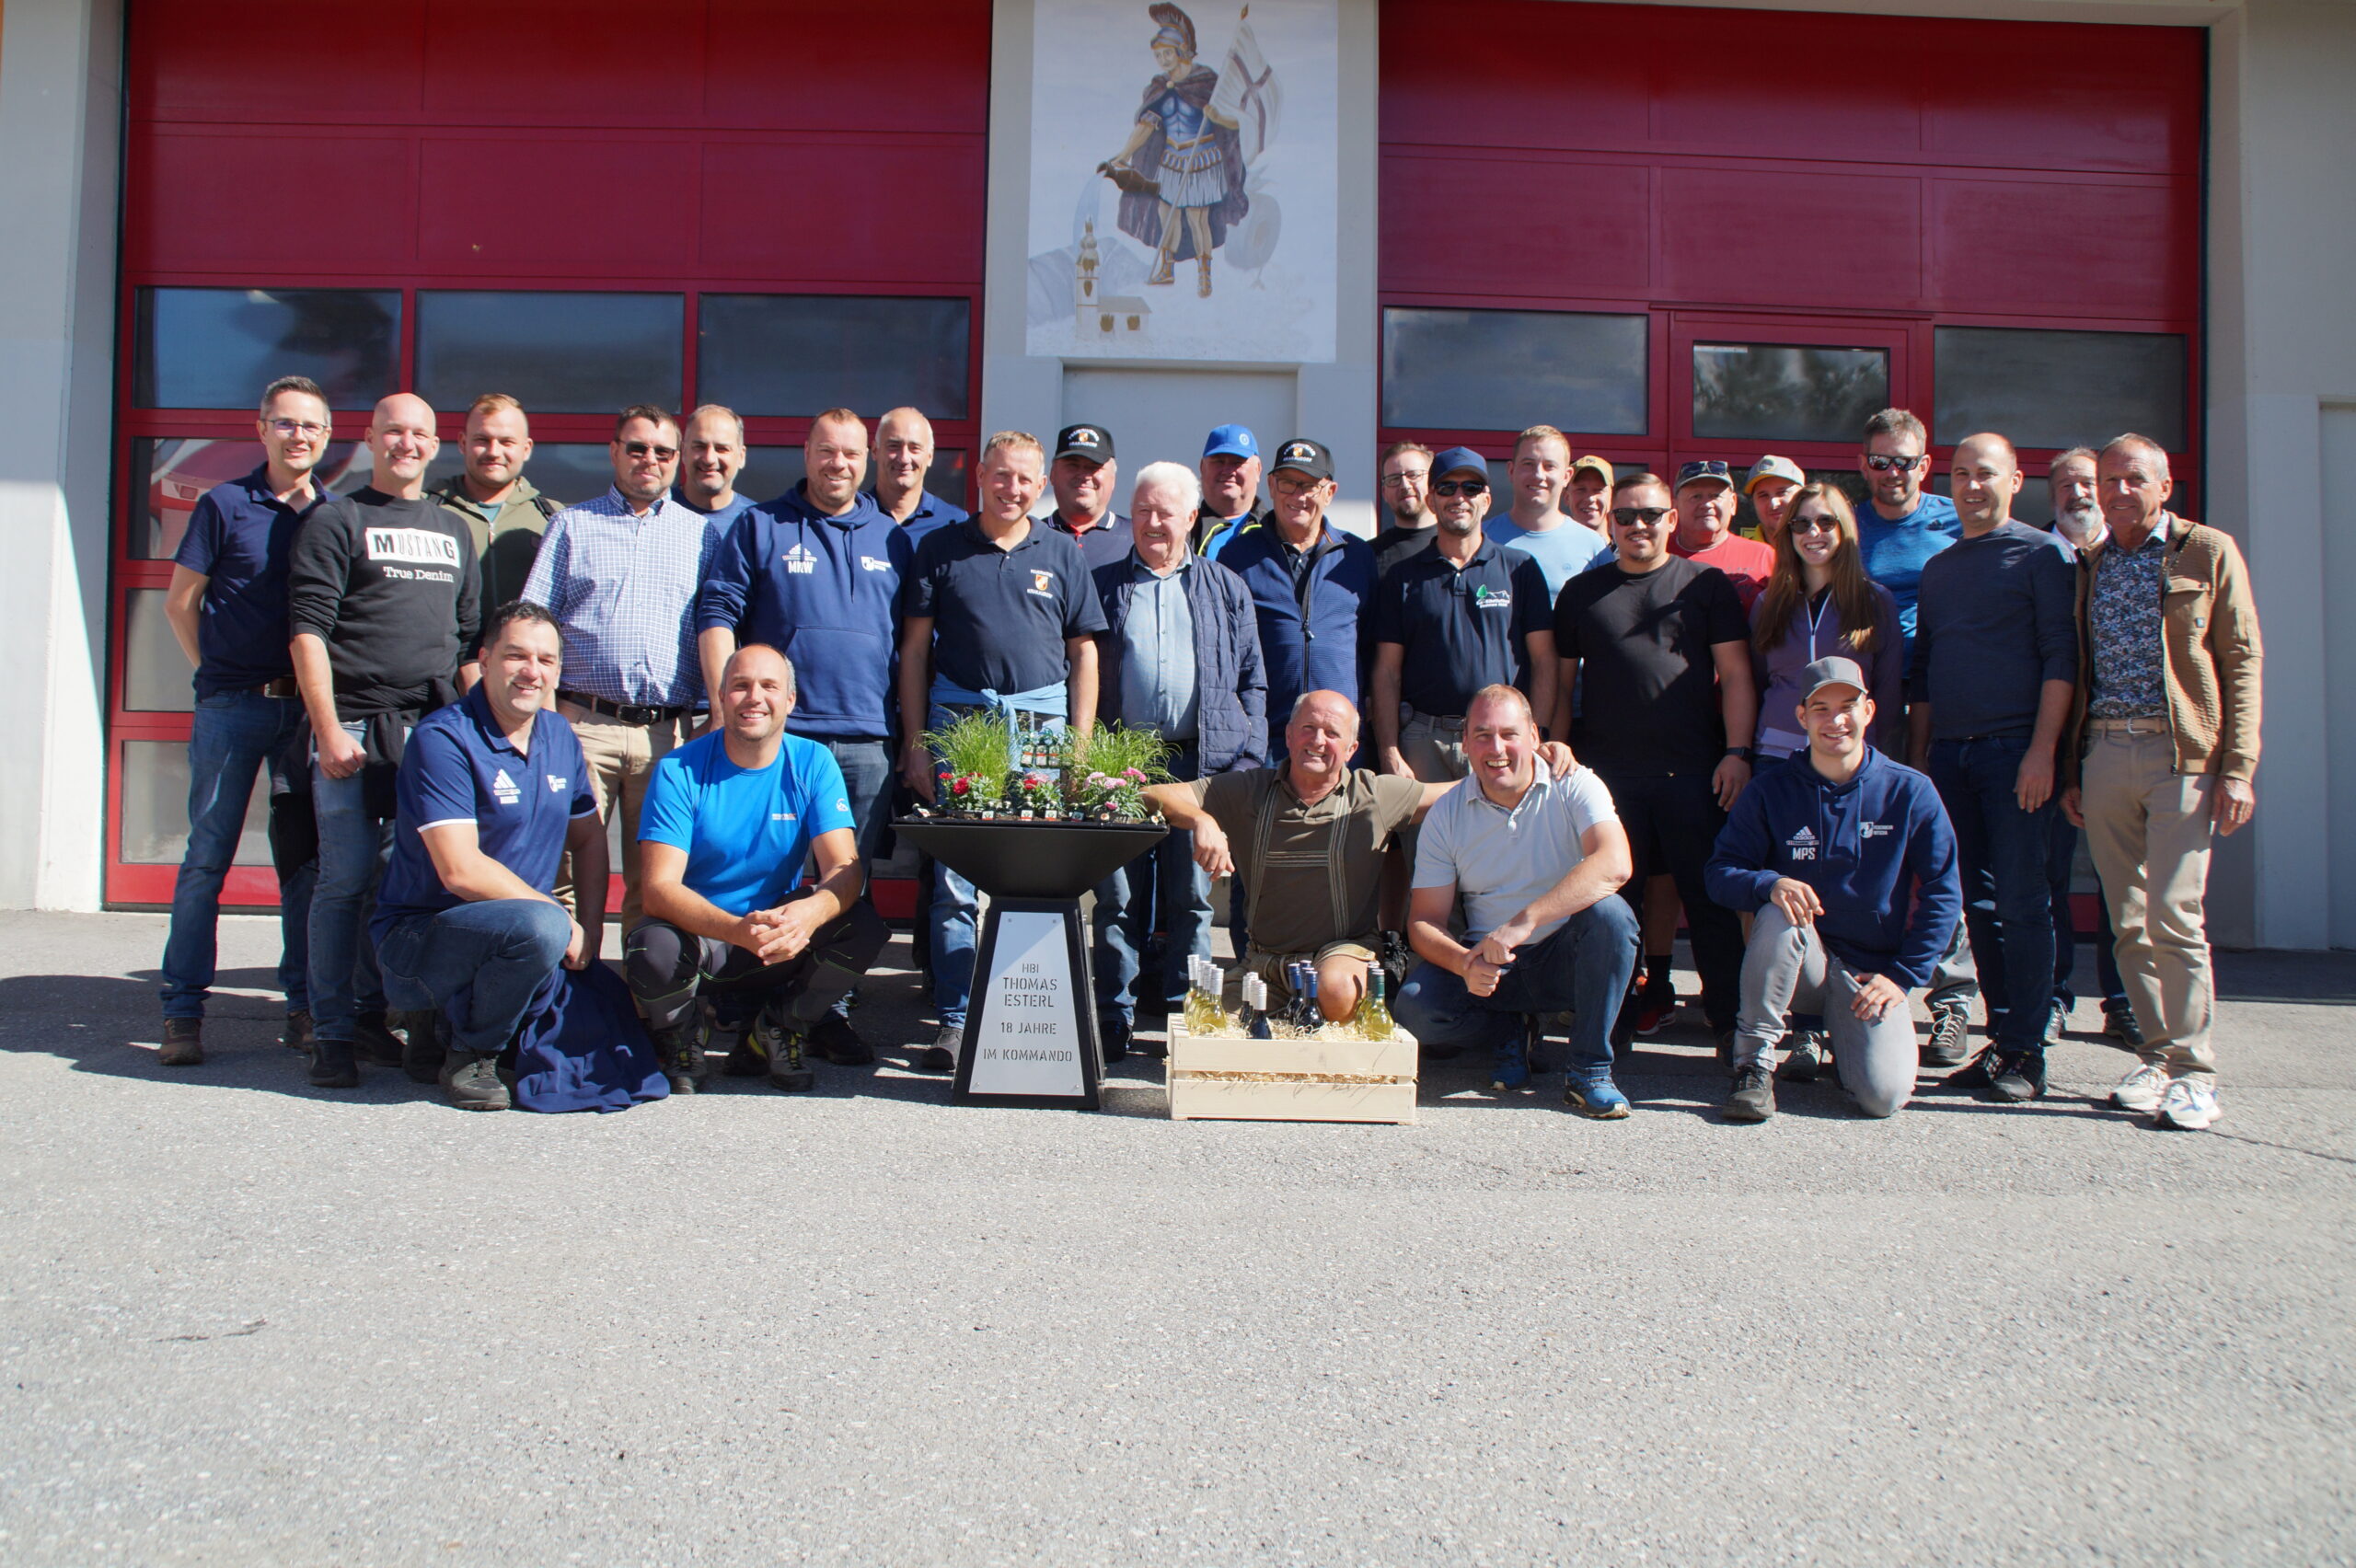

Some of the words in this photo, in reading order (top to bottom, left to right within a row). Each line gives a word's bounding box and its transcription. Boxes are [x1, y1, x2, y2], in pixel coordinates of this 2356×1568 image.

[373, 534, 456, 560] MUSTANG
[383, 566, 412, 580] True
[414, 569, 455, 582] Denim
[1792, 847, 1816, 860] MPS
[1022, 963, 1039, 974] HBI
[1002, 977, 1057, 992] THOMAS
[1004, 994, 1055, 1008] ESTERL
[1000, 1021, 1013, 1033] 18
[1018, 1022, 1057, 1035] JAHRE
[983, 1048, 997, 1060] IM
[1002, 1049, 1073, 1062] KOMMANDO
